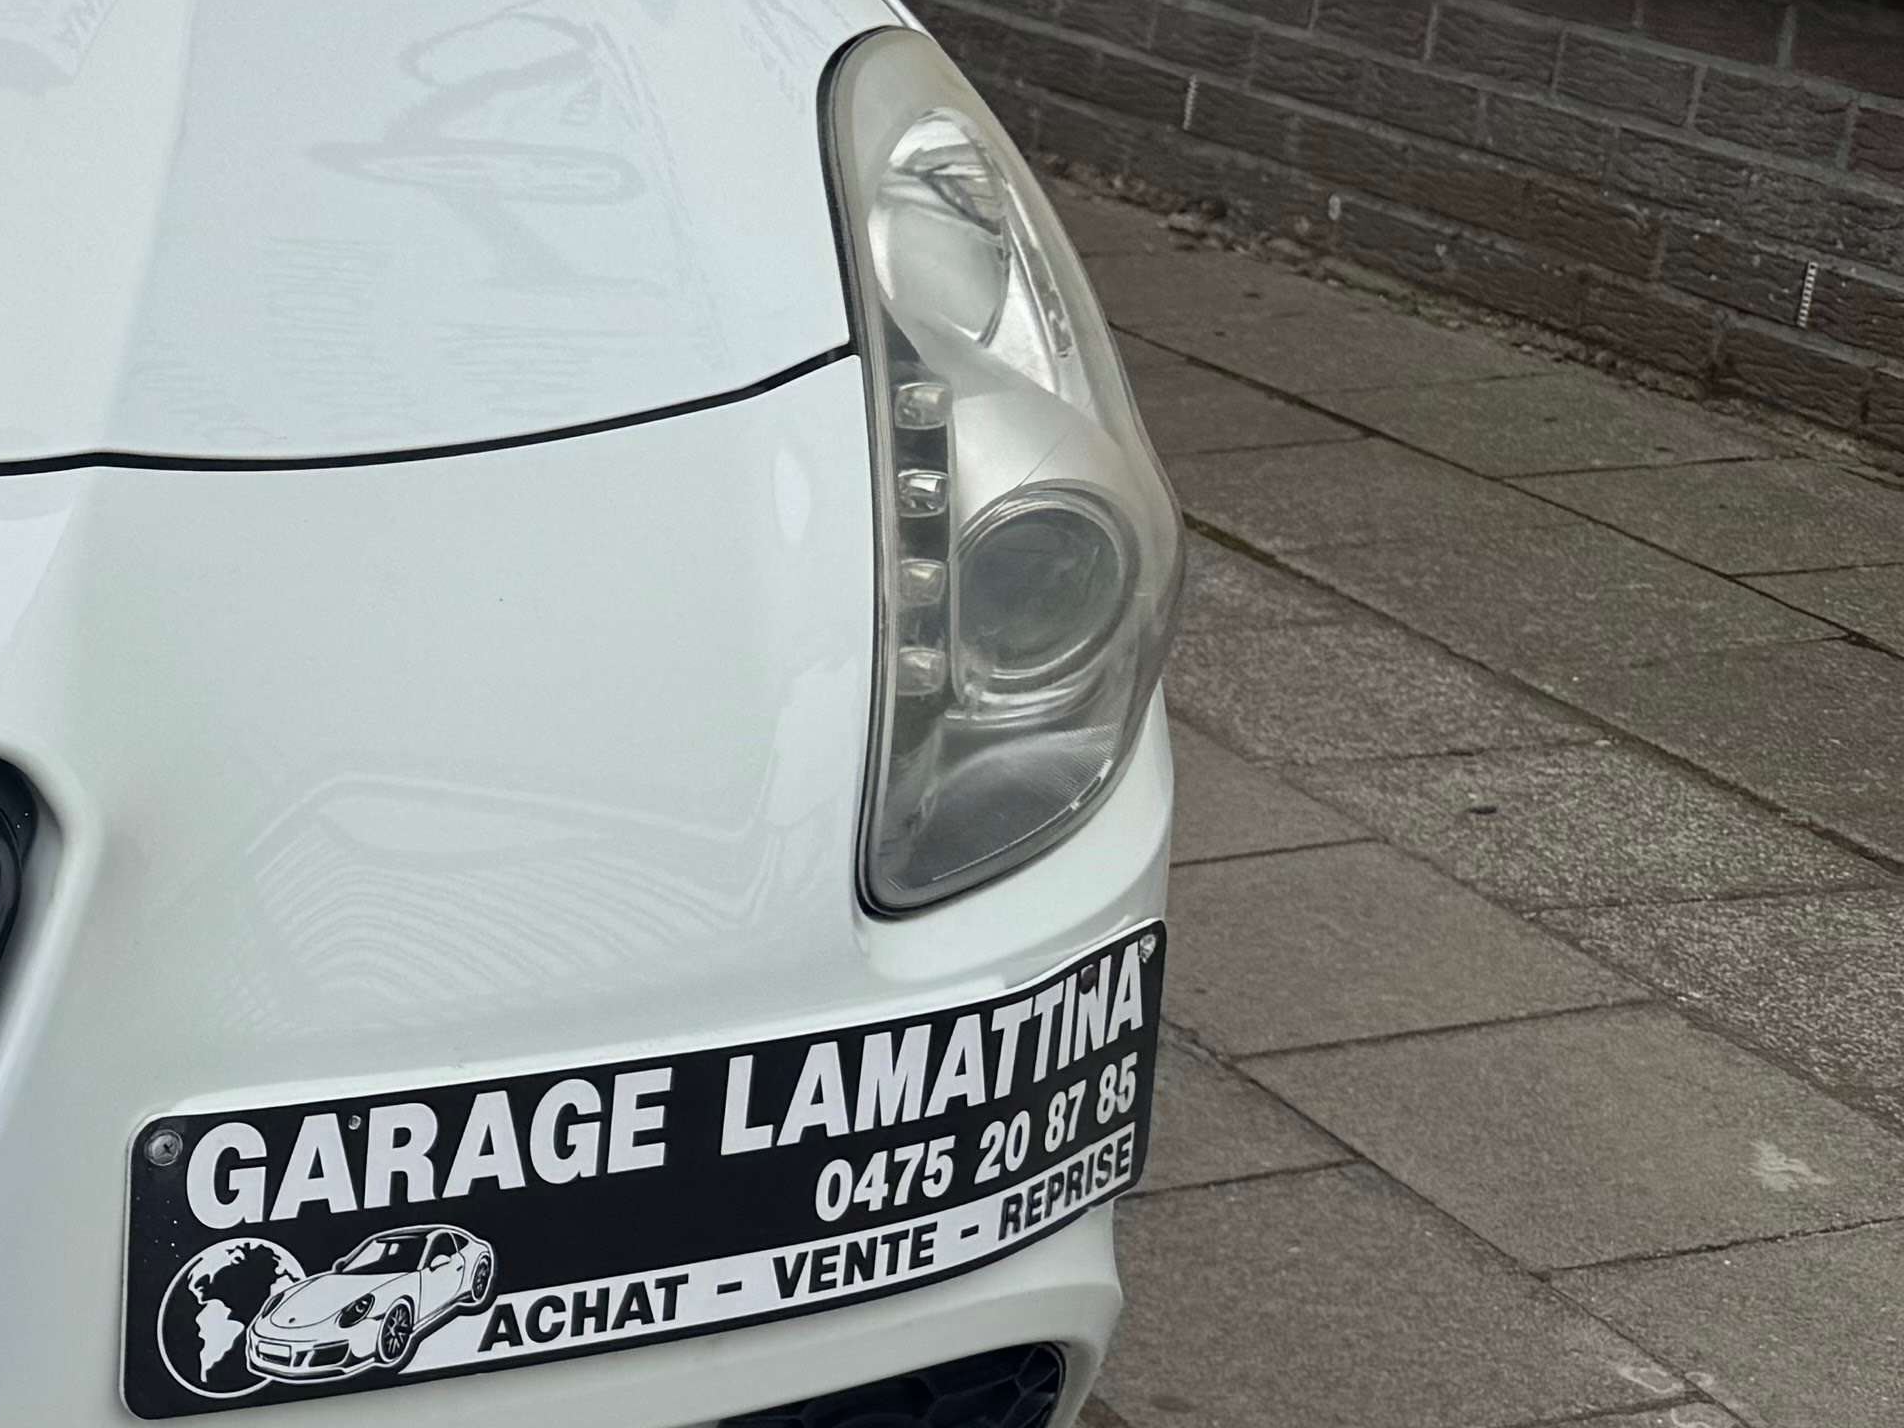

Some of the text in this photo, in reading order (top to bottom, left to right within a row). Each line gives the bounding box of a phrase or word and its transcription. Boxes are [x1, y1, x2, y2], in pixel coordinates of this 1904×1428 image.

[186, 940, 1144, 1230] GARAGE LAMATTINA
[815, 1051, 1138, 1222] 0475 20 87 85
[477, 1273, 690, 1353] ACHAT
[772, 1221, 939, 1300] VENTE
[998, 1131, 1133, 1242] REPRISE
